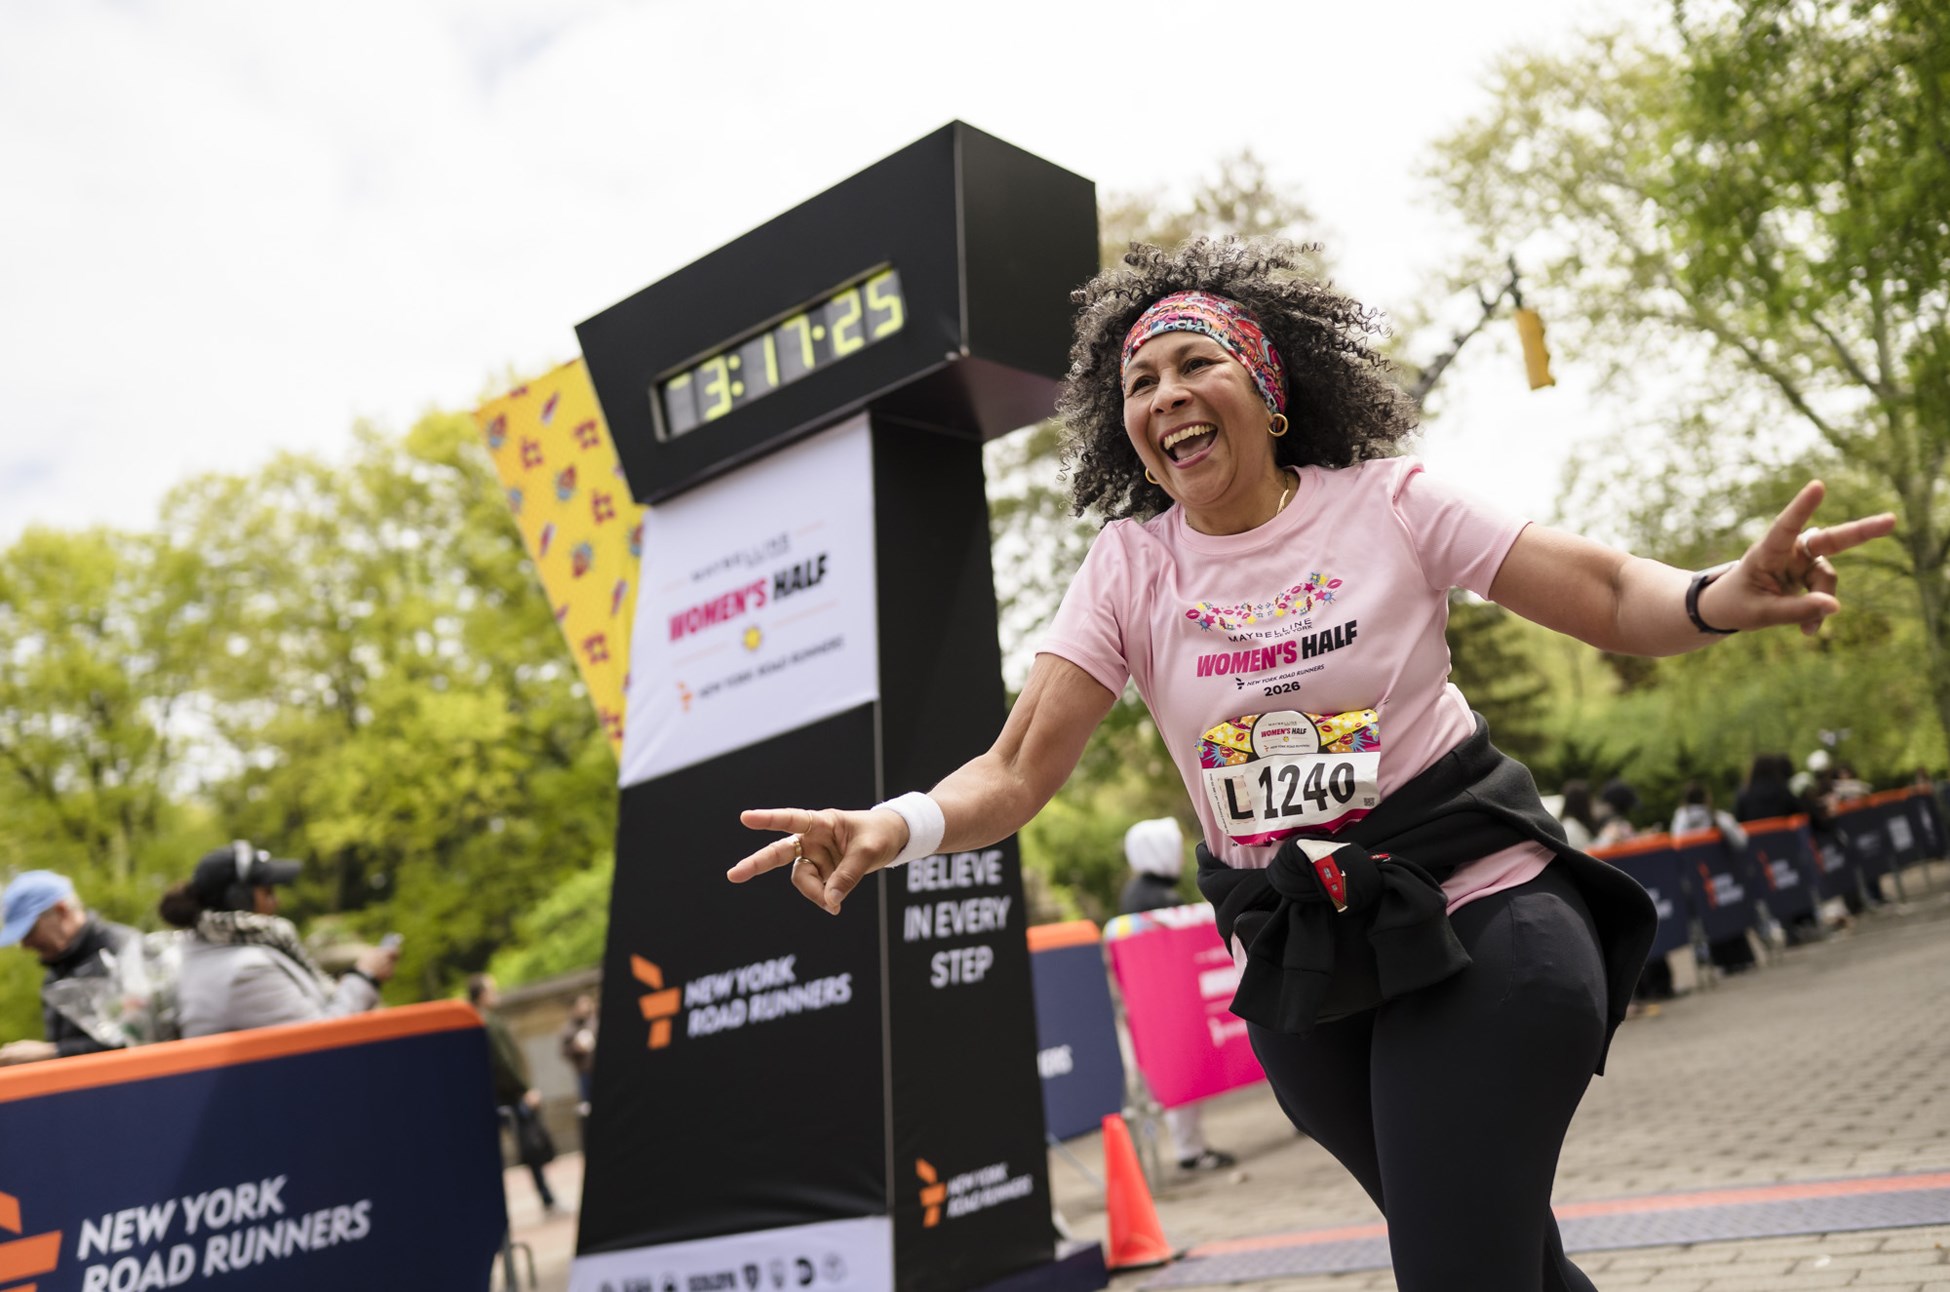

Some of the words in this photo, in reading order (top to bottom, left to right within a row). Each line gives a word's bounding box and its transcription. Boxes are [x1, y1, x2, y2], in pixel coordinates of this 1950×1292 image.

[669, 578, 767, 642] WOMEN'S
[773, 553, 827, 600] HALF
[1197, 640, 1297, 677] WOMEN'S
[1302, 620, 1357, 660] HALF
[1228, 618, 1312, 642] MAYBELLINE
[1292, 625, 1312, 633] YORK
[1264, 681, 1301, 696] 2026
[1279, 671, 1295, 680] ROAD
[1296, 664, 1325, 676] RUNNERS
[1261, 728, 1291, 737] WOMEN'S
[1224, 778, 1254, 819] L
[1258, 762, 1356, 820] 1240
[907, 850, 1003, 893] BELIEVE
[904, 903, 932, 941] IN
[935, 895, 1012, 938] EVERY
[684, 969, 735, 1009] NEW
[735, 954, 796, 994] YORK
[930, 945, 994, 989] STEP
[687, 998, 747, 1038] ROAD
[748, 972, 852, 1023] RUNNERS
[77, 1200, 176, 1261] NEW
[181, 1174, 289, 1235] YORK
[81, 1243, 197, 1292] ROAD
[202, 1199, 372, 1278] RUNNERS
